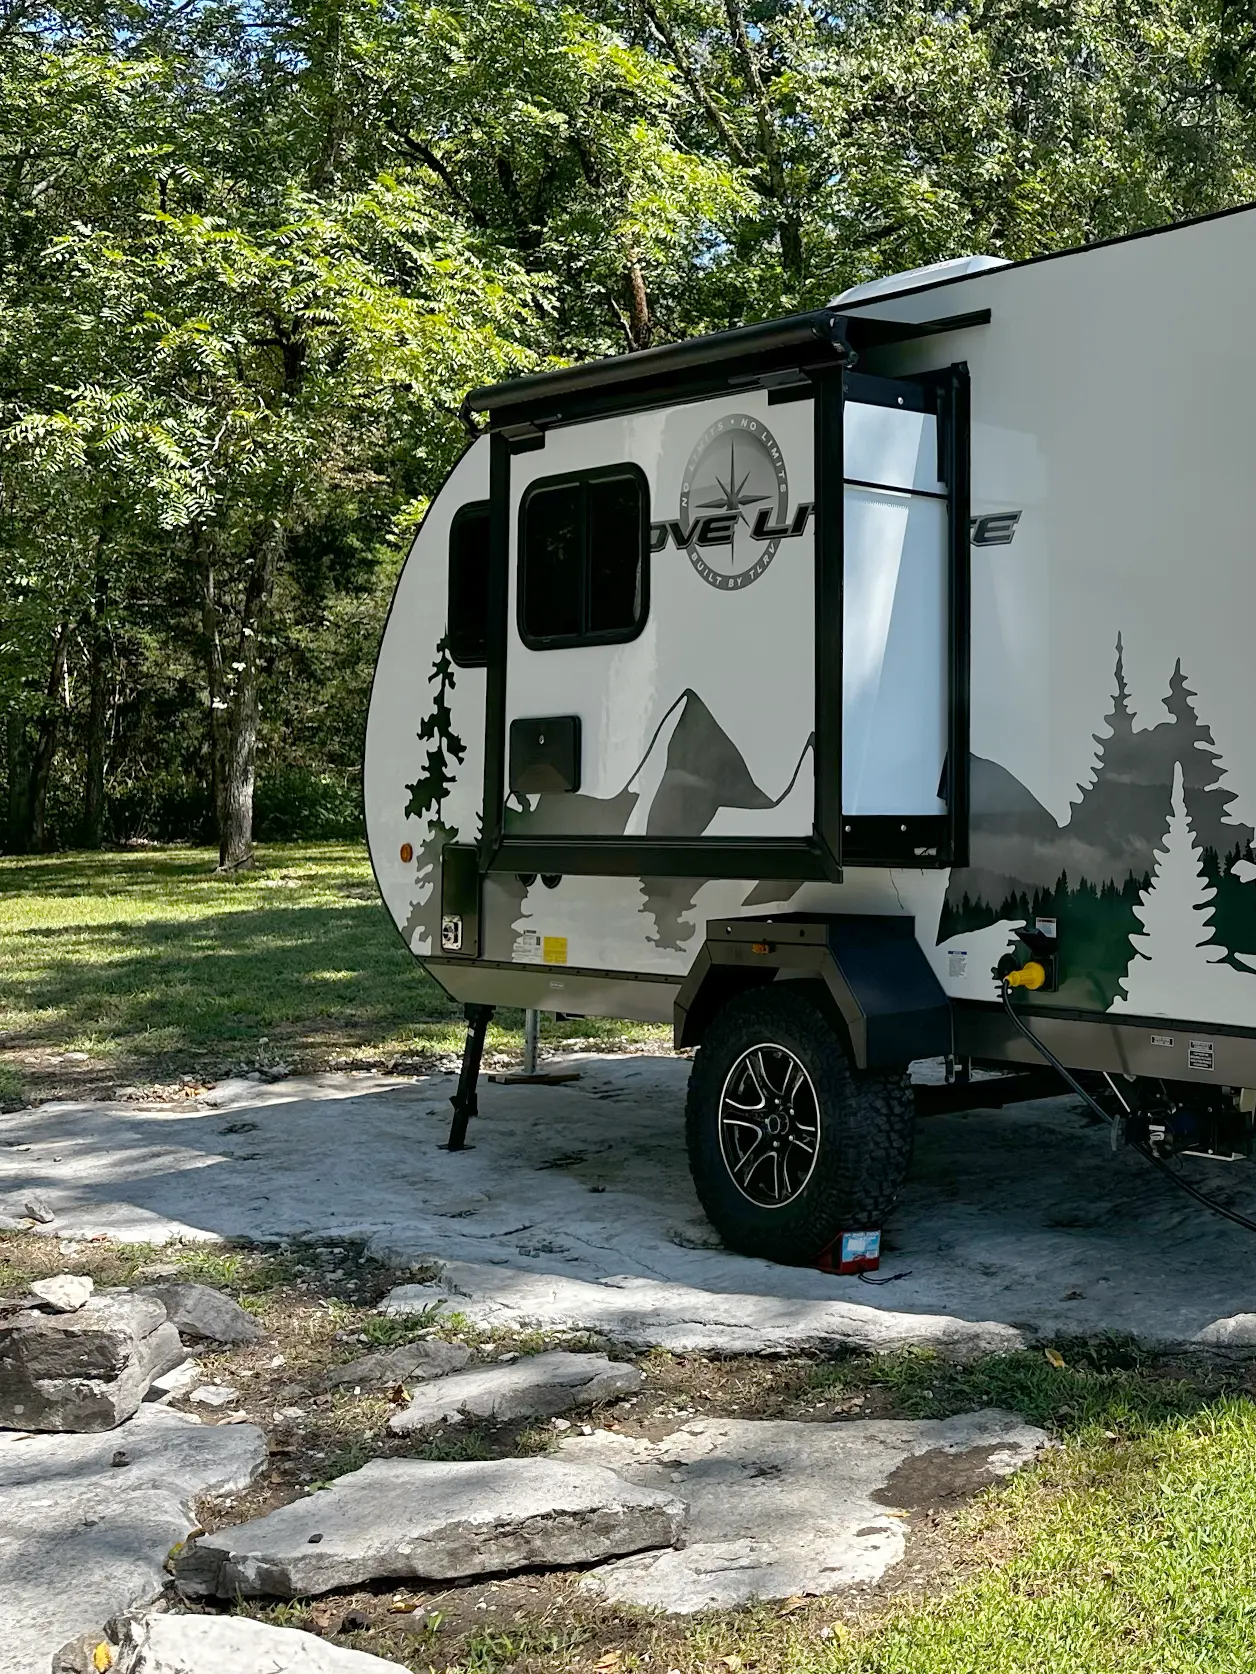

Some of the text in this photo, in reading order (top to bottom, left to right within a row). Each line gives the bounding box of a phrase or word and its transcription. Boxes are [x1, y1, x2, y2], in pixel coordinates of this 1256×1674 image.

[681, 482, 690, 507] NO
[740, 418, 757, 431] NO
[761, 431, 787, 493] LIMITS
[691, 543, 775, 588] BUILT BY TLRV
